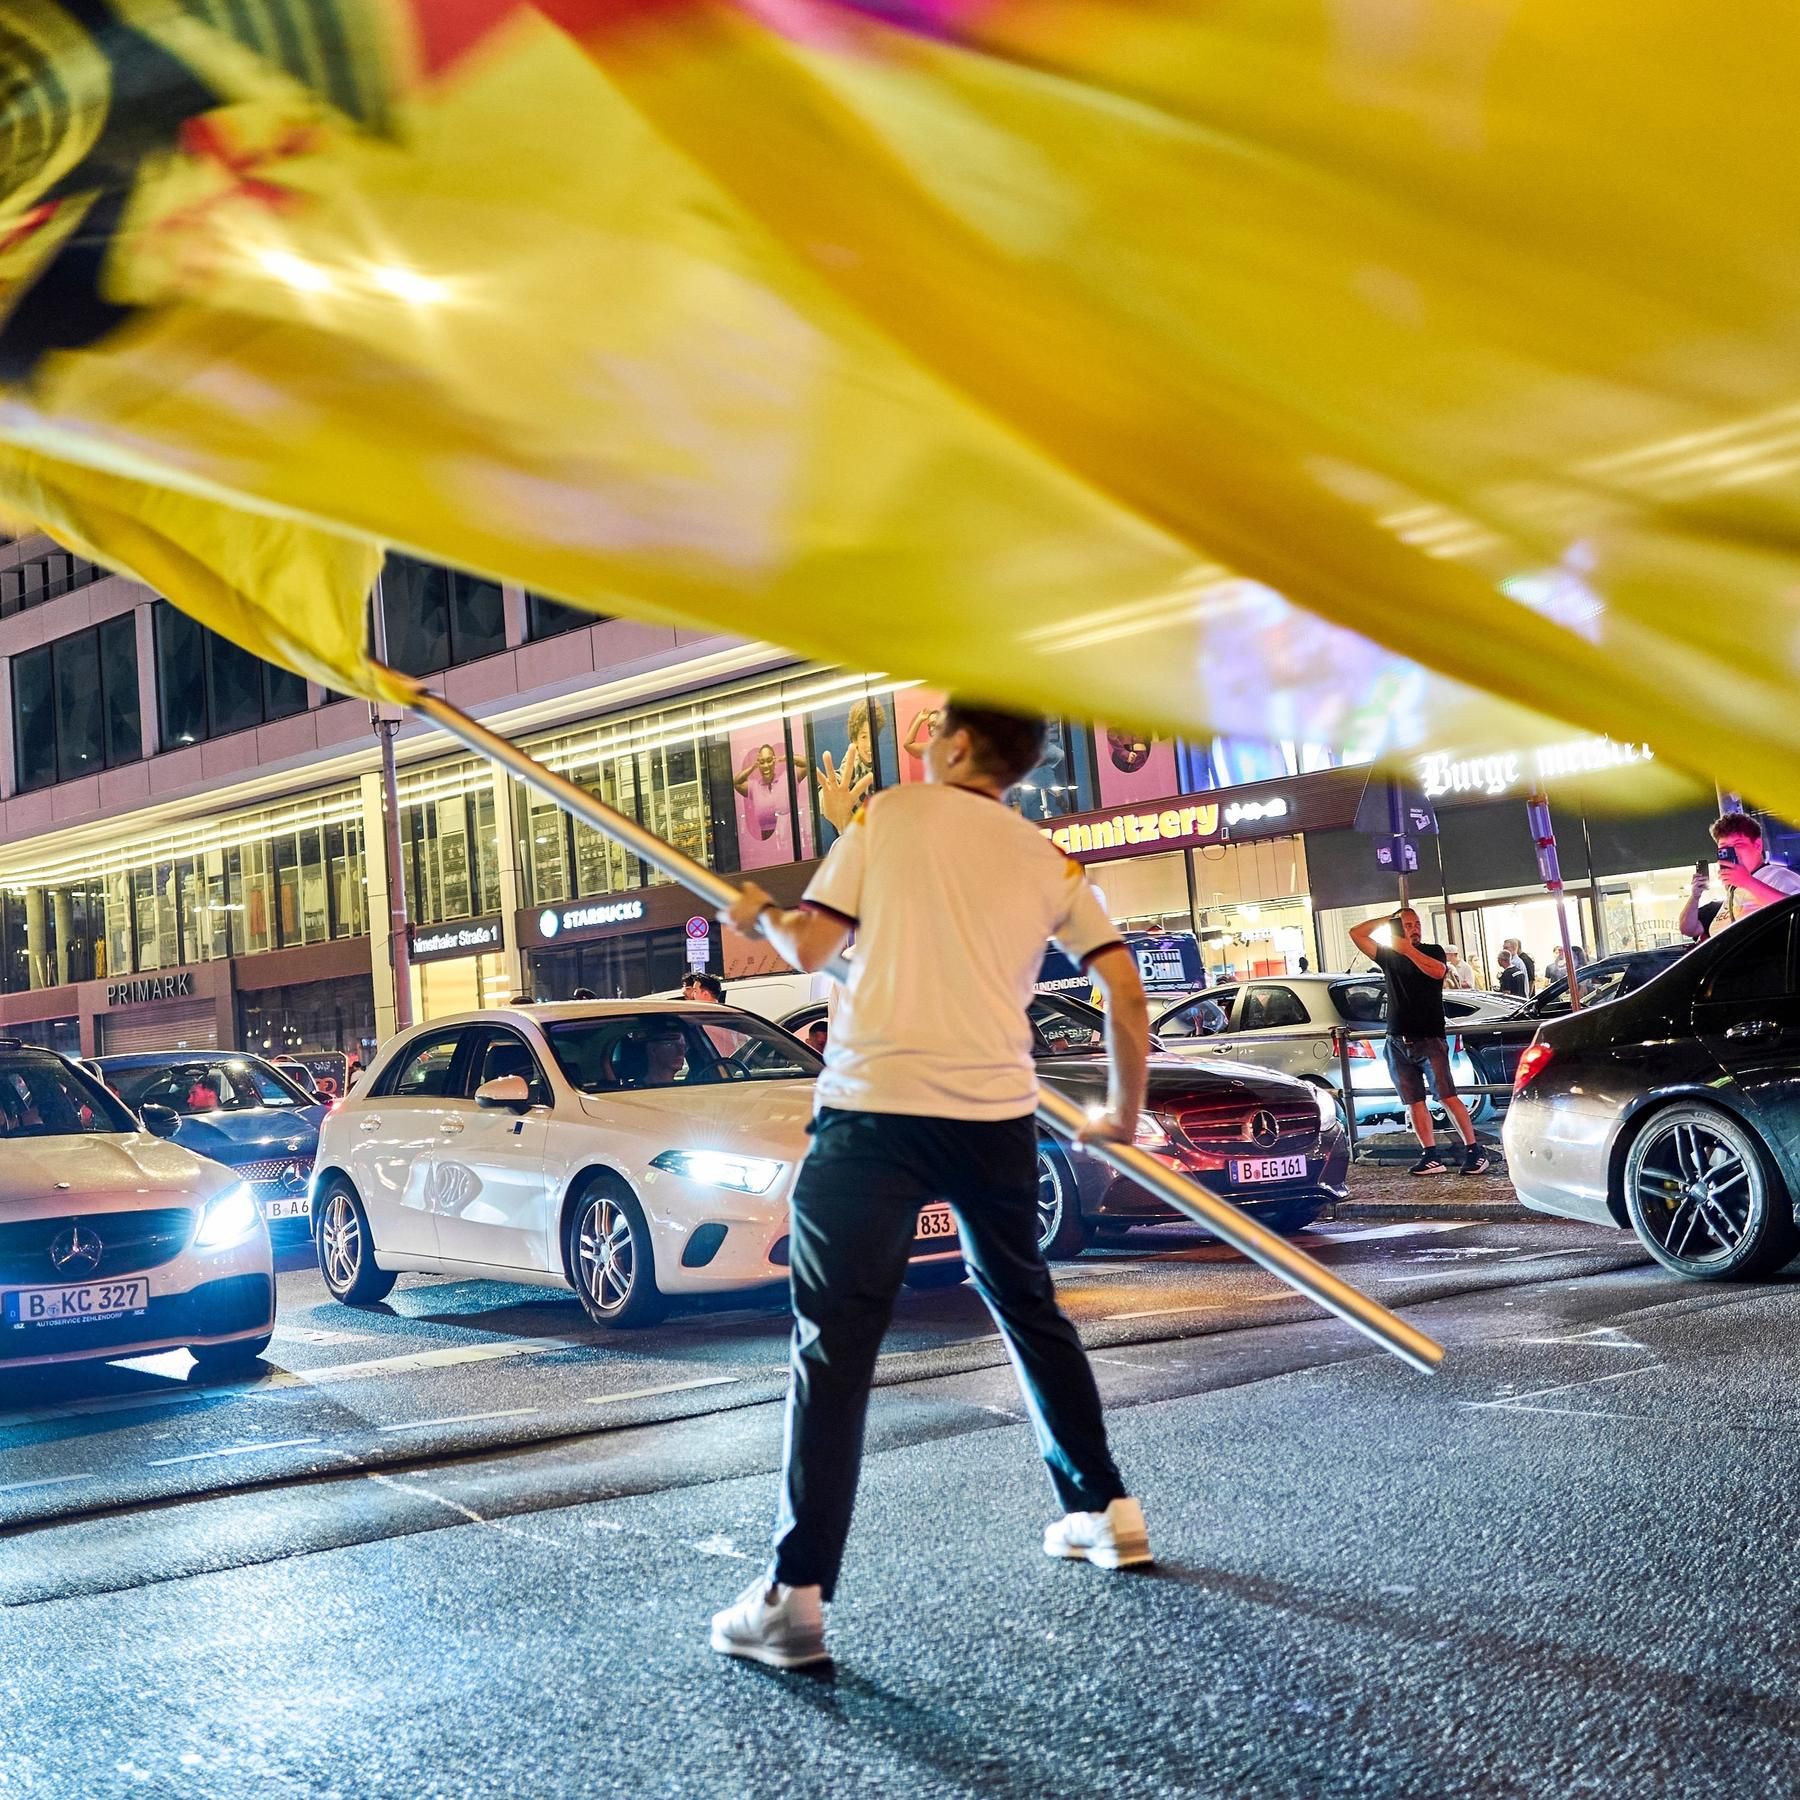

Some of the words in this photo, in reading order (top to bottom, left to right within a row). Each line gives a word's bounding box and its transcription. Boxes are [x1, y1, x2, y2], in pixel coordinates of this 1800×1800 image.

[563, 900, 643, 929] STARBUCKS
[458, 927, 491, 947] Straße
[491, 924, 498, 941] 1
[106, 973, 190, 1007] PRIMARK
[1243, 1162, 1252, 1180] B
[1261, 1160, 1279, 1178] EG
[1281, 1158, 1302, 1177] 161
[272, 1203, 281, 1217] B
[301, 1200, 309, 1213] 6
[921, 1213, 950, 1235] 833
[29, 1294, 46, 1318] B
[61, 1289, 92, 1314] KC
[98, 1283, 139, 1310] 327
[36, 1317, 81, 1328] AUTOSERVICE
[81, 1312, 123, 1323] ZEHLENDORF
